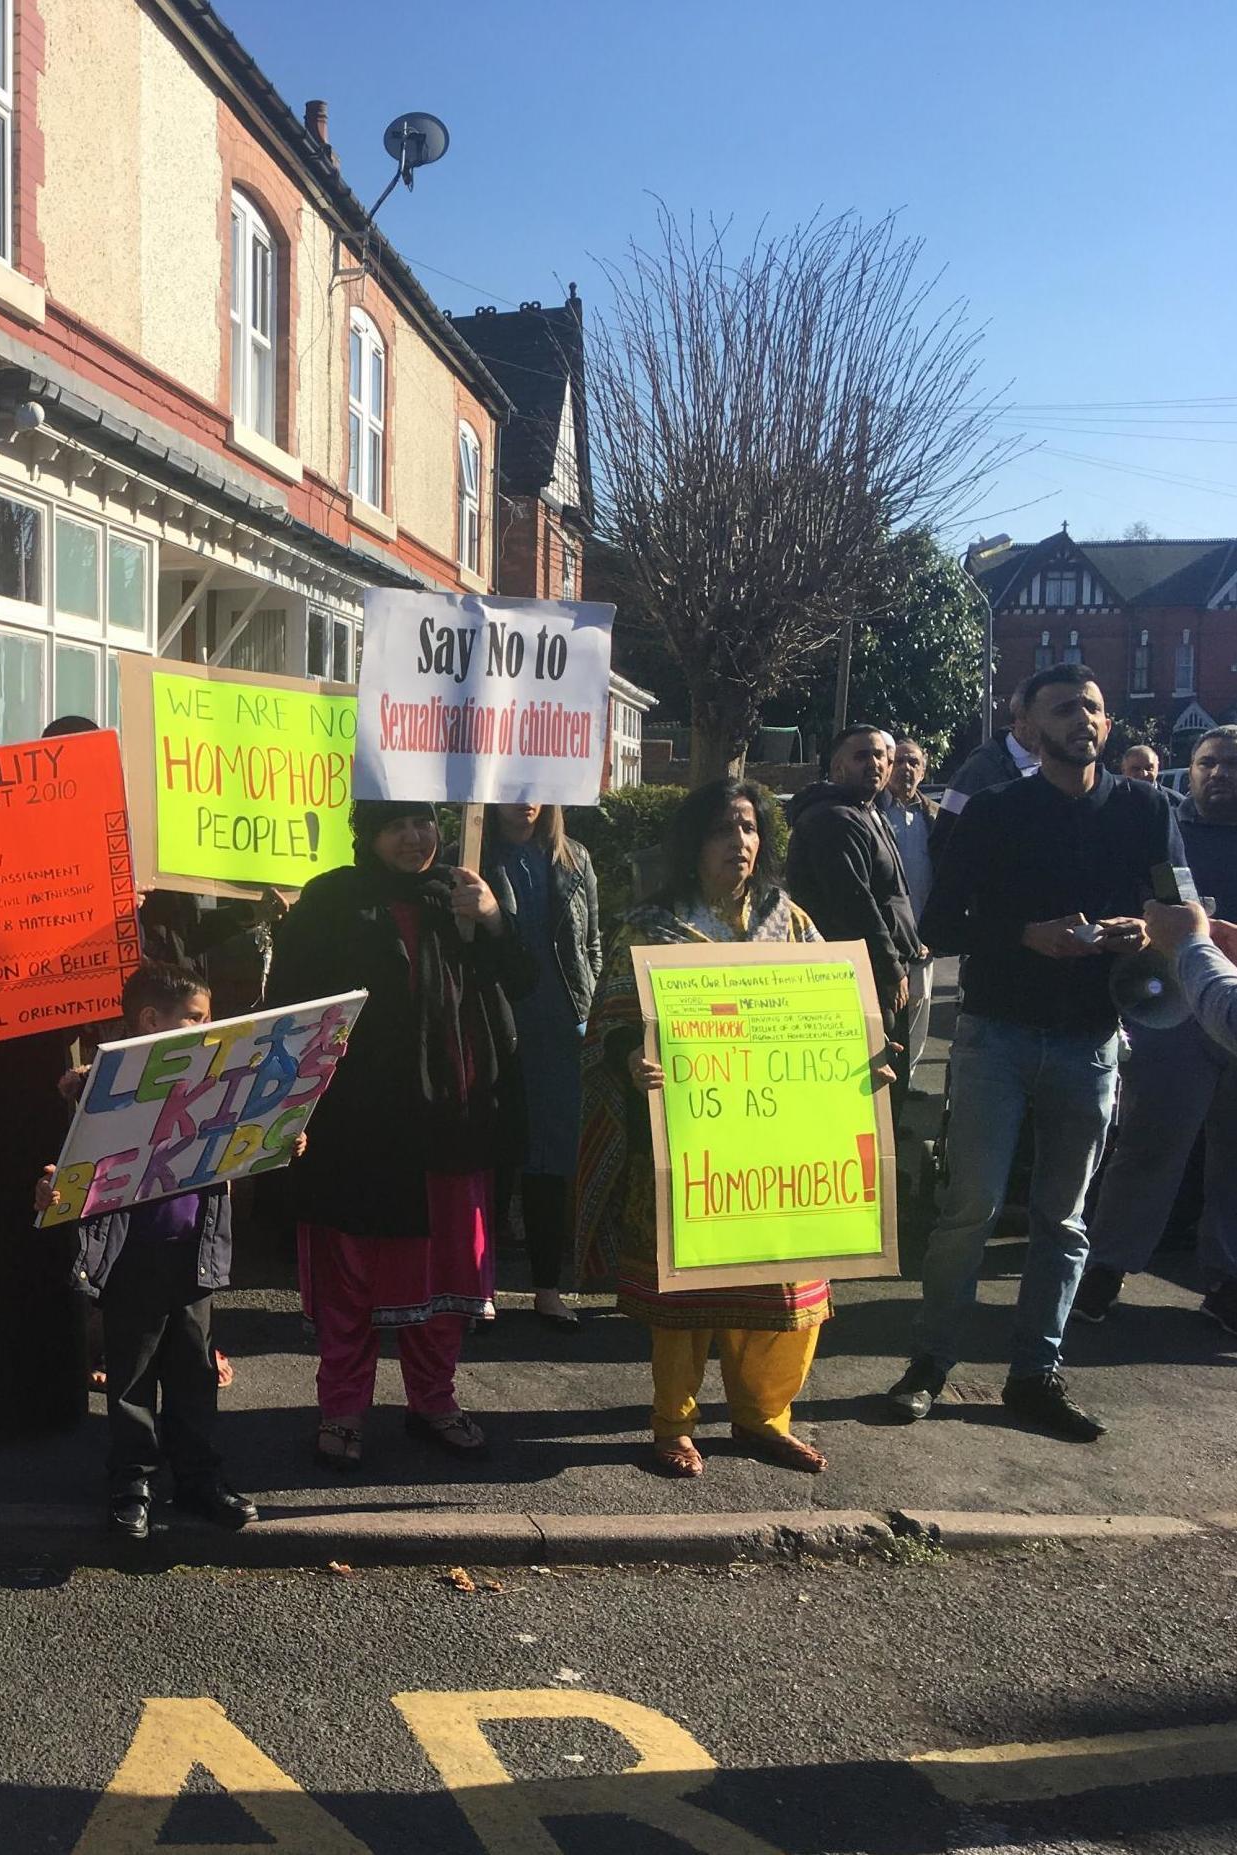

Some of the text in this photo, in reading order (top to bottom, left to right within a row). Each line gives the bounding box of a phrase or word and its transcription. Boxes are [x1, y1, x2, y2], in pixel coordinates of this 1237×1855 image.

[417, 616, 567, 683] Say No to
[166, 688, 212, 721] WE
[236, 698, 289, 732] ARE
[379, 692, 592, 760] Sexualisation of children
[26, 778, 78, 805] 2010
[197, 806, 320, 863] PEOPLE!
[3, 919, 13, 931] &
[19, 908, 94, 931] MATERNITY
[28, 959, 54, 976] OR
[60, 950, 112, 974] BELIEF
[18, 995, 122, 1023] ORIENTATION
[671, 1020, 750, 1039] HOMOPHOBIC
[85, 1021, 256, 1114] LET
[673, 1045, 850, 1084] DON'T CLASS
[149, 1041, 348, 1147] KIDS
[689, 1086, 777, 1119] US AS
[41, 1105, 309, 1229] BE KIDS
[683, 1132, 876, 1219] HOMOPHOBIC!
